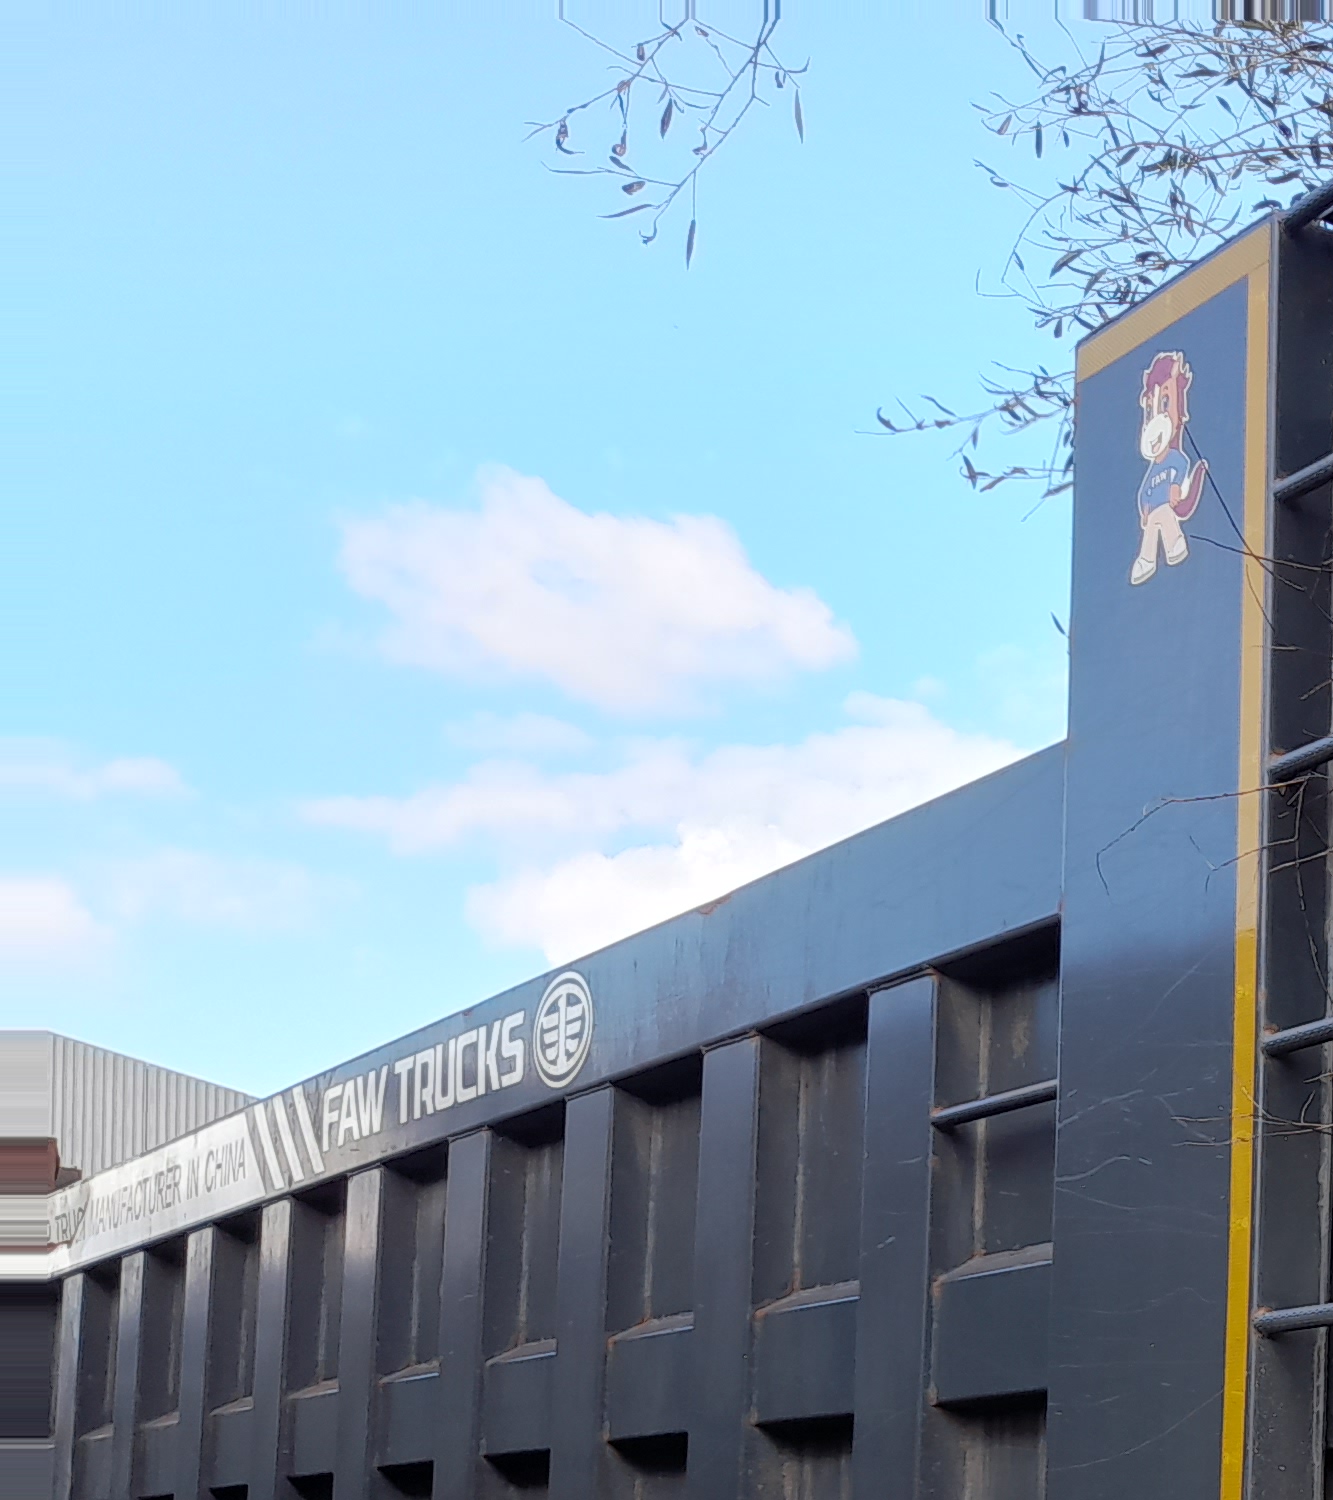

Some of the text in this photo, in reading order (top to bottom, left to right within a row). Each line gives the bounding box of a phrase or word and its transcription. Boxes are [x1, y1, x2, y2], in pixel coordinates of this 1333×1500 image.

[322, 1009, 526, 1152] FAW TRUCKS
[90, 1163, 182, 1237] MANUFACTURER
[186, 1155, 200, 1200] IN
[204, 1136, 246, 1193] CHINA
